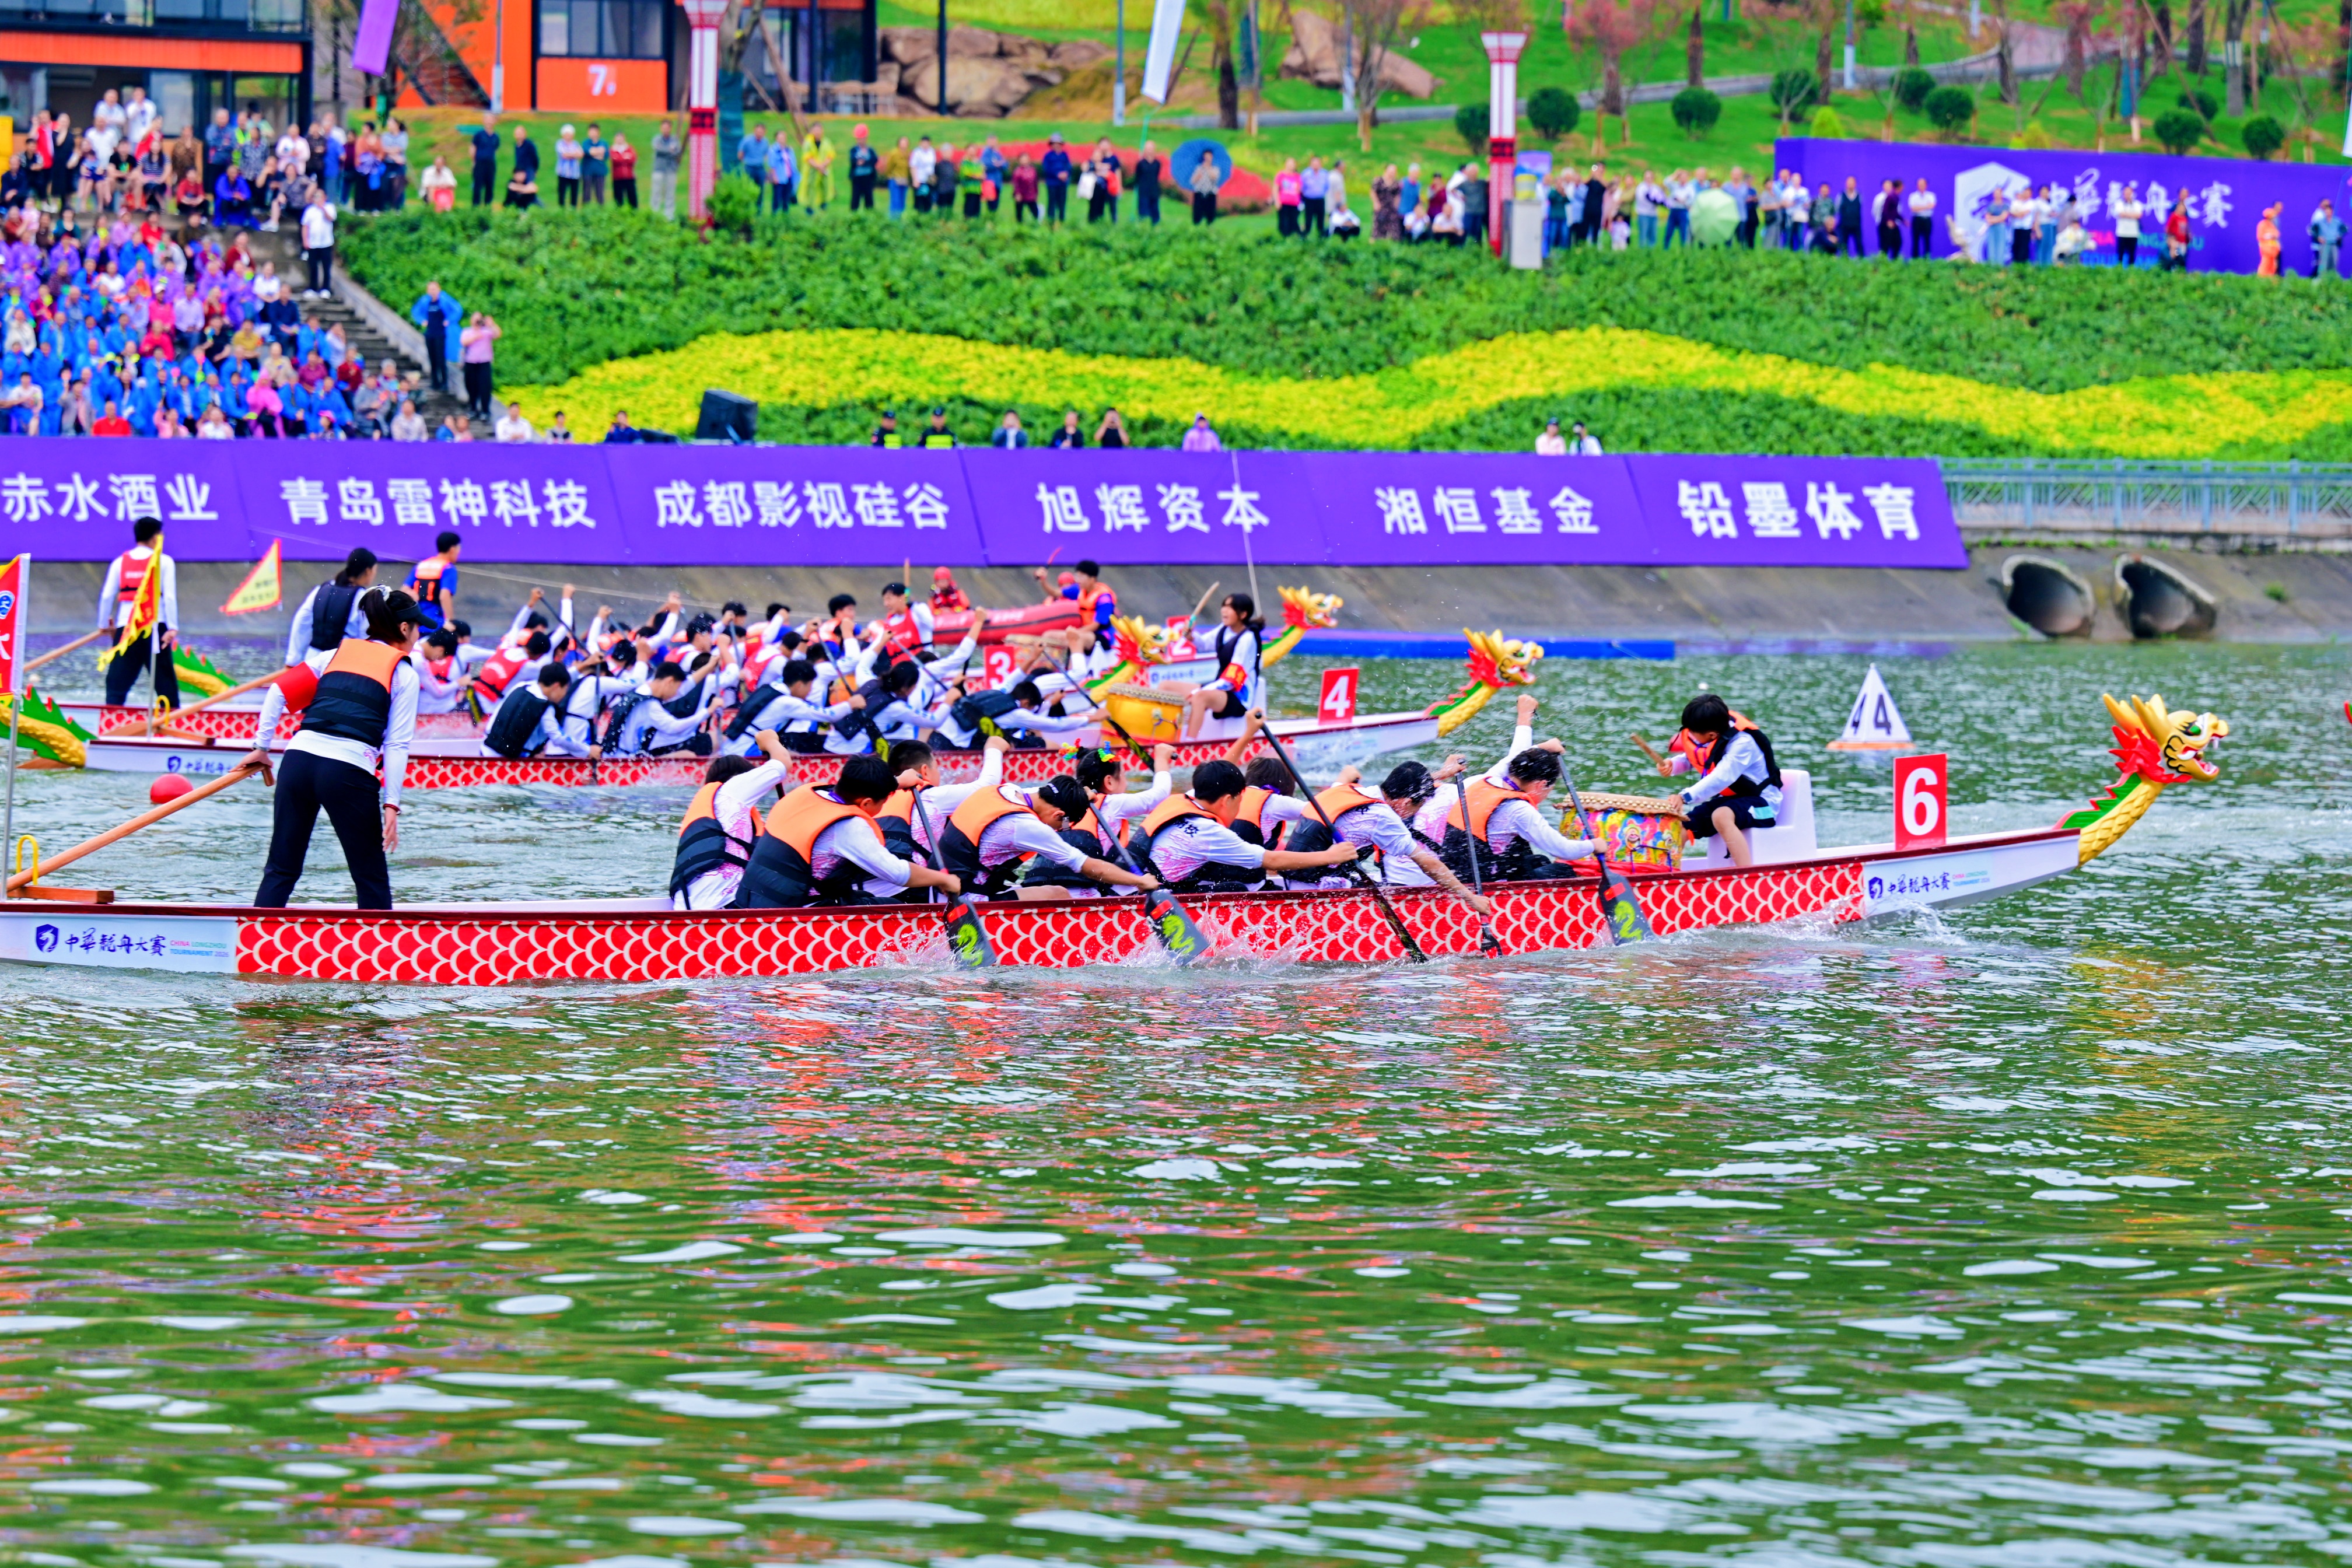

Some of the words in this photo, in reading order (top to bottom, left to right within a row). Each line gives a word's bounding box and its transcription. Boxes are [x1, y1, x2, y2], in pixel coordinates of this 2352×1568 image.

[1, 472, 219, 523] 赤水酒业
[280, 476, 596, 529] 青岛雷神科技
[654, 480, 950, 530] 成都影视硅谷
[1035, 482, 1270, 533] 旭辉资本
[1374, 486, 1600, 535] 湘恒基金
[1677, 480, 1920, 541] 铅墨体育
[989, 652, 1011, 691] 3
[1323, 676, 1351, 718] 4
[1874, 694, 1892, 736] 4
[1902, 767, 1940, 836] 6
